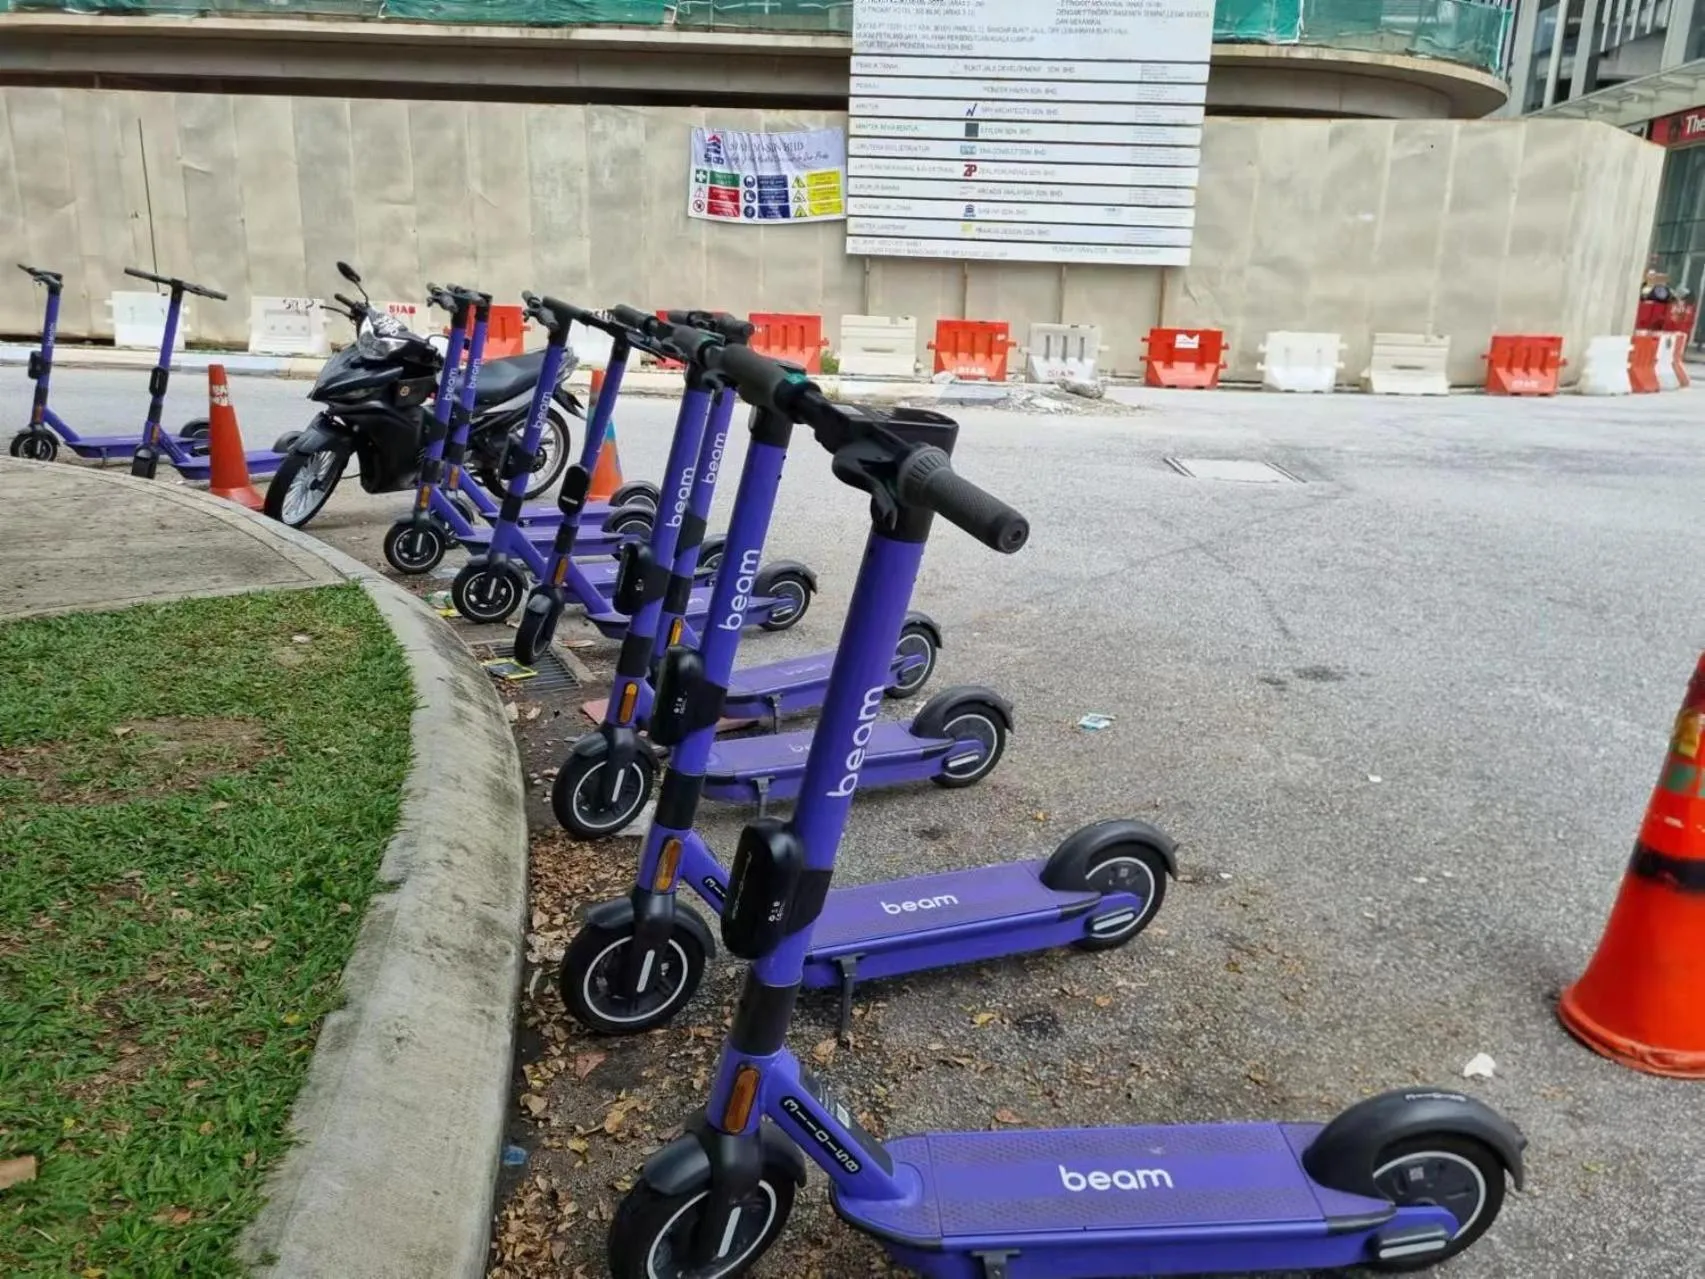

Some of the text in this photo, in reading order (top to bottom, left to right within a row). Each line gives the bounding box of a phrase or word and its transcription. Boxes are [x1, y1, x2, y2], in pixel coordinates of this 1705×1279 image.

[442, 367, 458, 401] beam
[467, 358, 481, 389] beam
[532, 391, 553, 429] beam
[701, 431, 727, 485] beam
[665, 466, 695, 529] beam
[717, 548, 761, 631] beam
[825, 684, 885, 797] beam
[880, 894, 959, 915] beam
[1058, 1164, 1174, 1192] beam
